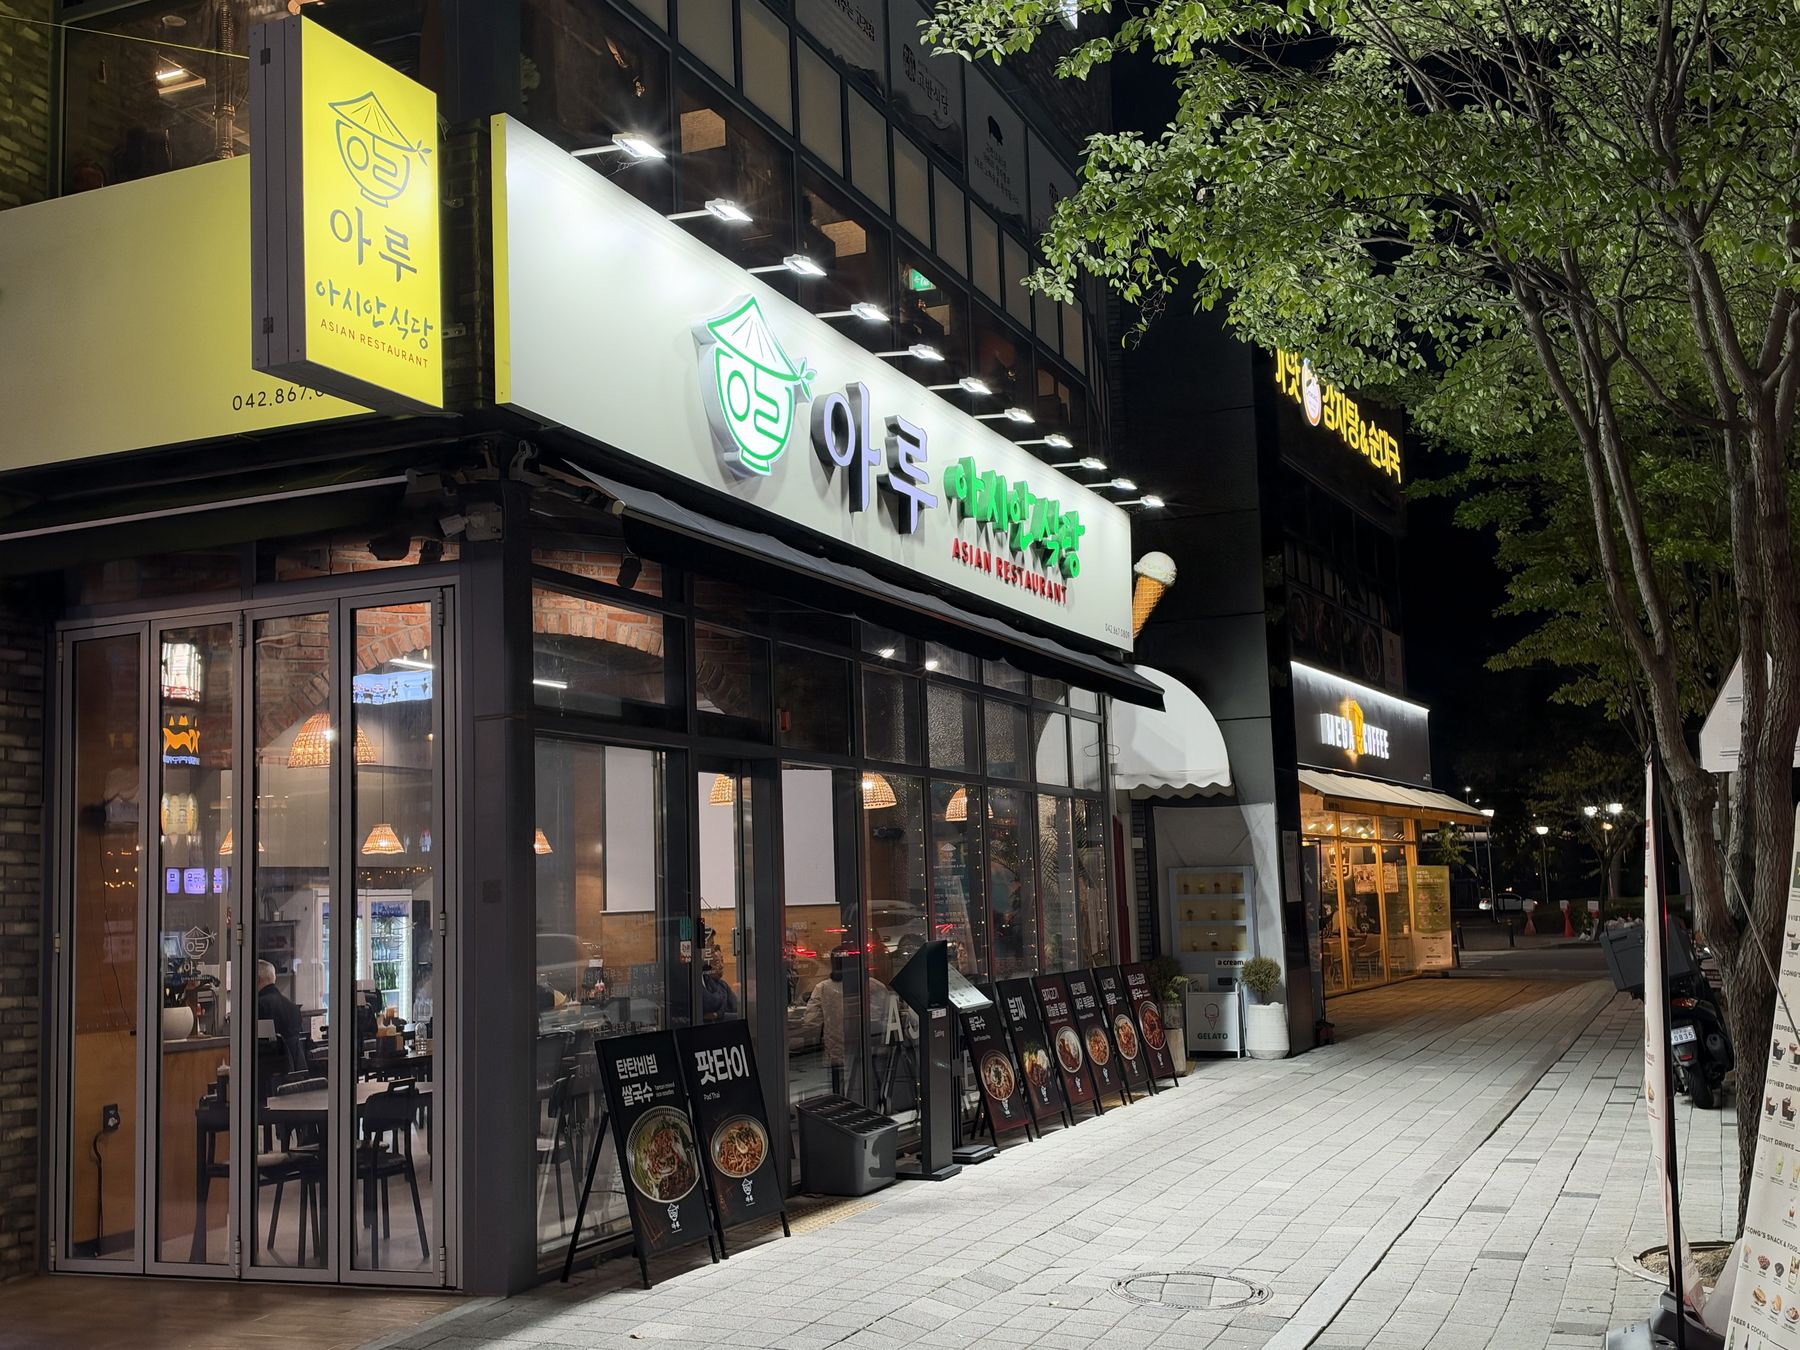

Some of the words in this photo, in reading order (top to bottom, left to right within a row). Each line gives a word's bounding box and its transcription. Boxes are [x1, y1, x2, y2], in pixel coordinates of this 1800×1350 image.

[330, 206, 417, 282] 아루
[320, 318, 356, 341] ASIAN
[360, 333, 429, 369] RESTAURANT
[818, 381, 939, 535] 아루
[951, 537, 992, 575] ASIAN
[995, 556, 1067, 606] RESTAURANT
[1322, 714, 1355, 751] MEGA
[1007, 995, 1027, 1022] 분짜
[1197, 1032, 1229, 1041] GELATO
[1674, 1031, 1694, 1042] 0835
[615, 1053, 659, 1081] 탄탄비빔
[694, 1044, 750, 1086] 팟타이
[621, 1081, 654, 1107] 쌀국수
[1775, 1139, 1795, 1151] DRINKS
[1767, 1234, 1783, 1247] SNACK
[1733, 1316, 1746, 1326] BEER
